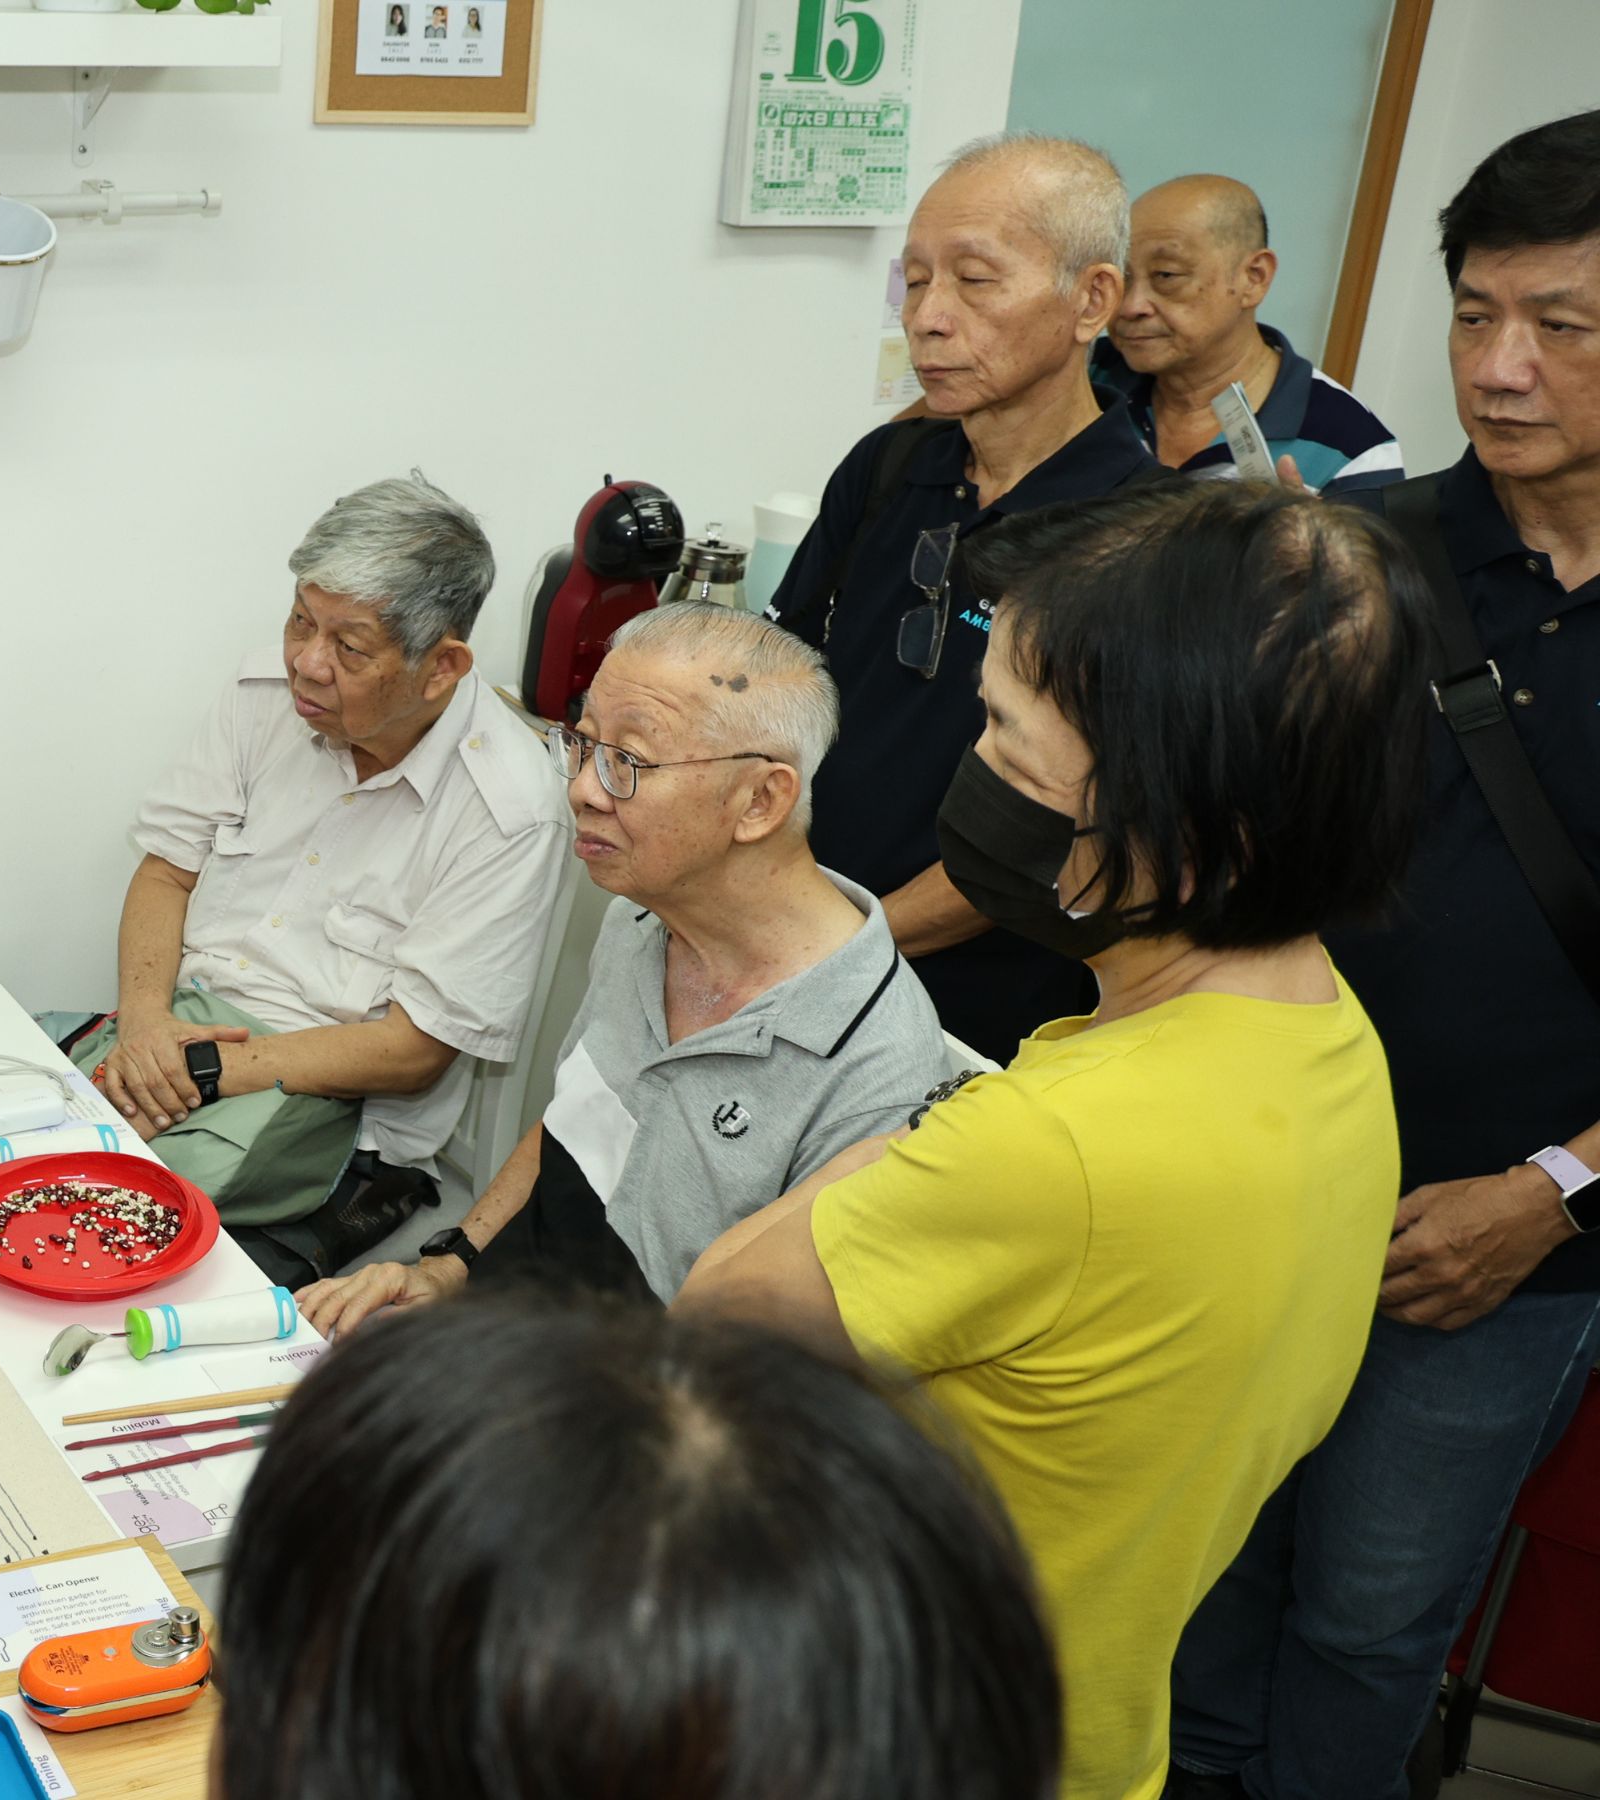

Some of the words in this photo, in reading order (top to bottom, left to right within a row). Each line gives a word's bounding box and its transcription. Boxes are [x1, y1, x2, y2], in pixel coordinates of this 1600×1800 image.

[979, 599, 996, 614] Ge
[959, 609, 992, 632] AMB
[269, 1348, 319, 1363] Mobility
[111, 1418, 160, 1433] Mobility
[131, 1514, 160, 1534] ge+
[9, 1586, 44, 1598] Electric
[45, 1582, 64, 1590] Can
[65, 1576, 100, 1587] Opener
[36, 1597, 66, 1606] kitchen
[67, 1591, 95, 1603] gadget
[21, 1608, 53, 1619] arthritis
[63, 1600, 88, 1610] hands
[46, 1613, 73, 1624] energy
[75, 1607, 97, 1616] when
[34, 1754, 61, 1791] Dining
